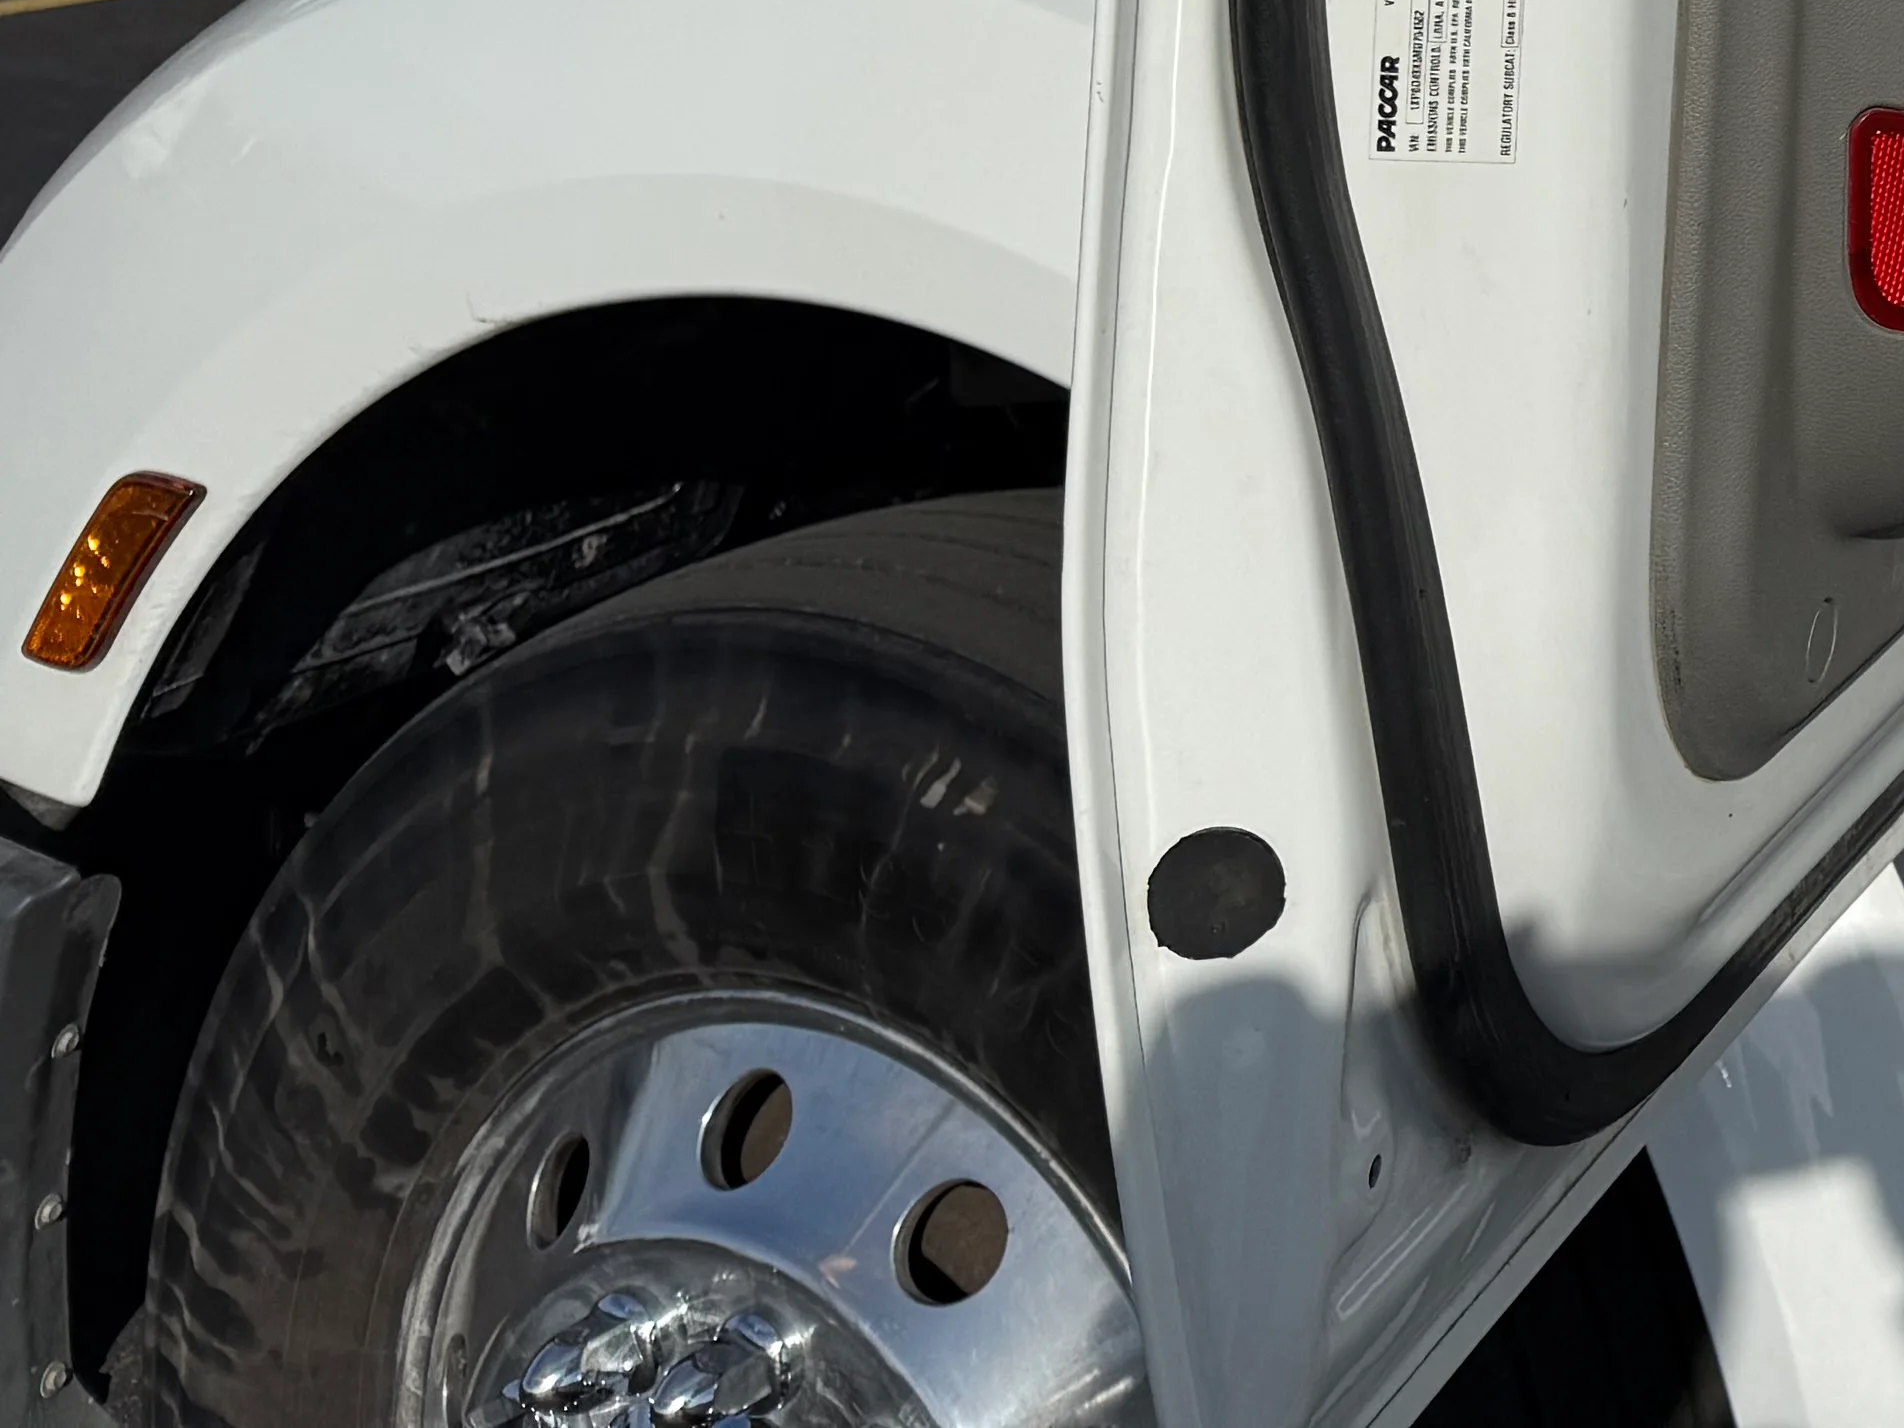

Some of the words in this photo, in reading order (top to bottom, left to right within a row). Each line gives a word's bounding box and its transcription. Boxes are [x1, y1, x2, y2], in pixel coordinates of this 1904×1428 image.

[1503, 49, 1516, 90] SUBCAT:
[1376, 55, 1400, 153] PACCAR
[1500, 93, 1514, 157] REGULATORY
